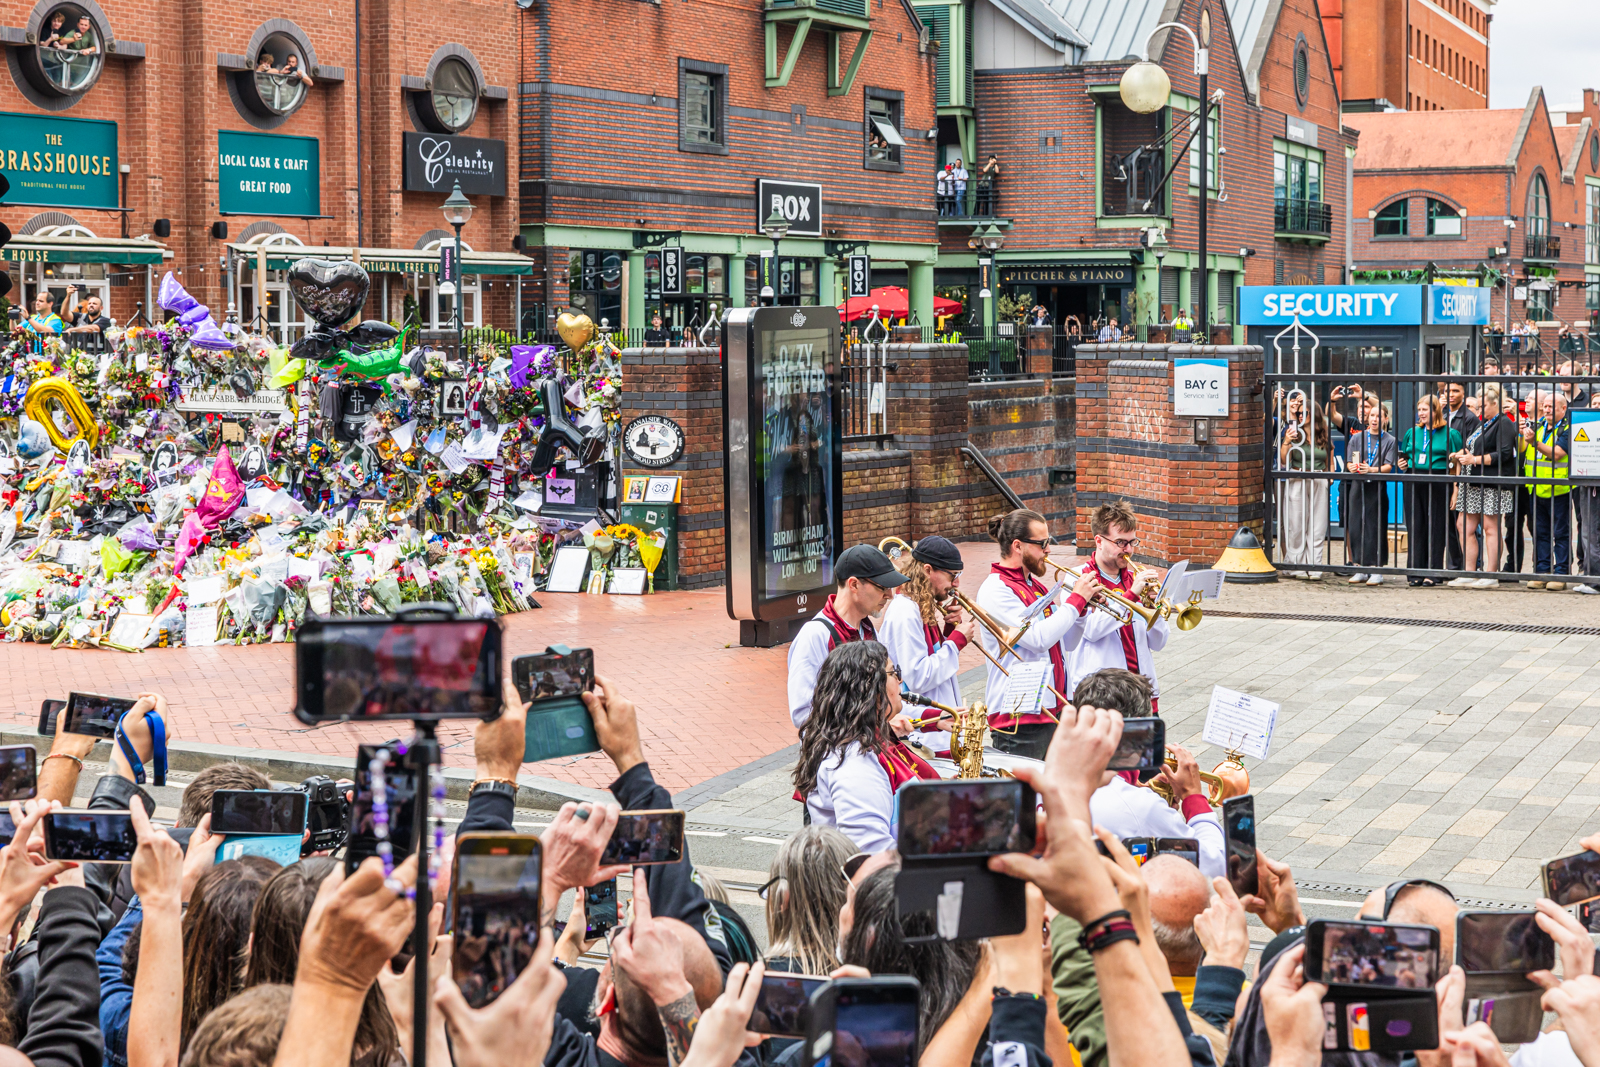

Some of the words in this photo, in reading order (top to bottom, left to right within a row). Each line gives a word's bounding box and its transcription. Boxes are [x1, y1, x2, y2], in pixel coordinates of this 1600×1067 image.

[45, 134, 62, 146] THE
[0, 149, 111, 176] BRASSHOUSE
[220, 154, 246, 167] LOCAL
[250, 156, 271, 168] CASK
[274, 157, 280, 169] &
[283, 158, 308, 171] CRAFT
[419, 137, 493, 188] Celebrity
[21, 181, 54, 189] TRADITIONAL
[240, 180, 266, 193] GREAT
[269, 182, 291, 194] FOOD
[772, 194, 810, 221] BOX
[12, 250, 48, 262] HOUSE
[405, 262, 424, 273] FREE
[666, 252, 677, 289] BOX
[853, 259, 864, 293] BOX
[1010, 271, 1066, 280] PITCHER
[1069, 272, 1077, 281] &
[1082, 270, 1124, 280] PIANO
[1263, 293, 1398, 317] SECURITY
[1441, 293, 1478, 316] SECURITY
[780, 343, 813, 369] OZZY
[767, 369, 825, 397] FOREVER
[1185, 380, 1207, 389] BAY
[1210, 380, 1218, 390] C
[190, 394, 214, 403] BLACK
[215, 395, 250, 404] SABBH
[252, 395, 281, 404] BRIDGE
[629, 416, 661, 431] CANALSIDE
[663, 419, 679, 433] WALK
[633, 452, 651, 464] BROAD
[653, 454, 674, 465] STREET
[773, 524, 824, 546] BIRMINGHAM
[772, 547, 793, 563] WILL
[782, 562, 800, 579] LOVE
[802, 559, 817, 574] YOU
